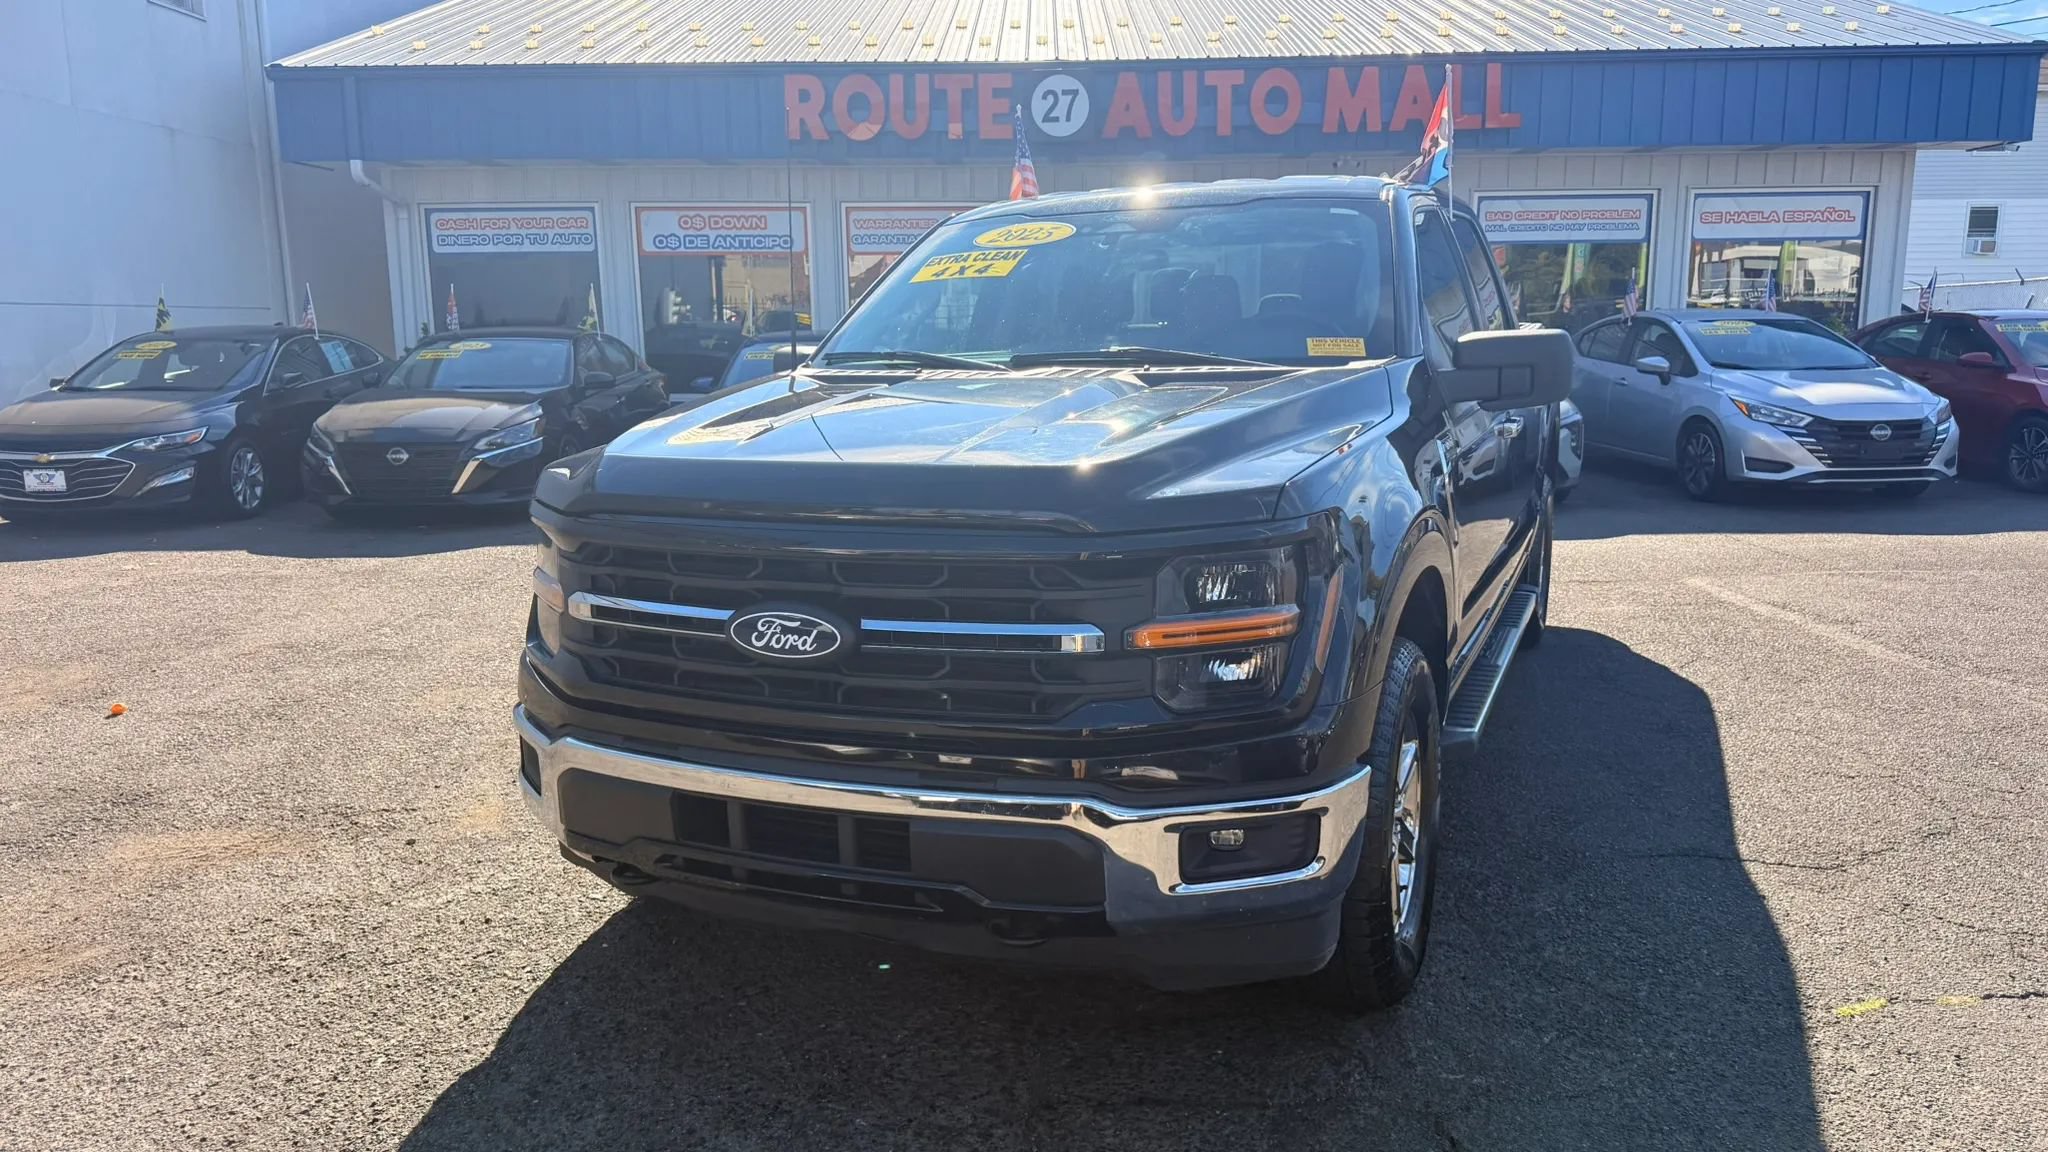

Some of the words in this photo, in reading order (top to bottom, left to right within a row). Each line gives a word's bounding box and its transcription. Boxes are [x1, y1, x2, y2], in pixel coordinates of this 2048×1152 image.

[784, 73, 1013, 141] ROUTE
[1041, 88, 1079, 123] 27
[1102, 67, 1302, 139] AUTO
[1322, 63, 1522, 134] MALL
[709, 215, 767, 230] DOWN
[1485, 211, 1513, 221] BAD
[1515, 210, 1558, 220] CREDIT
[1560, 210, 1580, 220] NO
[1582, 209, 1641, 220] PROBLEM
[1701, 212, 1723, 224] SE
[1725, 210, 1780, 223] HABLA
[1783, 207, 1856, 223] ESPAÑOL
[437, 218, 478, 230] CASH
[480, 218, 511, 229] FOR
[512, 217, 554, 229] YOUR
[556, 217, 588, 228] CAR
[1485, 224, 1508, 232] MAL
[1509, 223, 1548, 232] CREDITO
[1550, 223, 1566, 231] NO
[1567, 223, 1587, 231] HAY
[1587, 222, 1640, 231] PROBLEMA
[438, 234, 490, 246] DINERO
[493, 234, 524, 245] POR
[526, 234, 549, 245] TU
[551, 233, 593, 245] AUTO
[684, 236, 709, 249] DE
[712, 235, 793, 249] ANTICIPO
[988, 225, 1061, 244] 2025
[926, 253, 969, 267] EXTRA
[973, 249, 1024, 263] CLEAN
[751, 617, 818, 651] Ford
